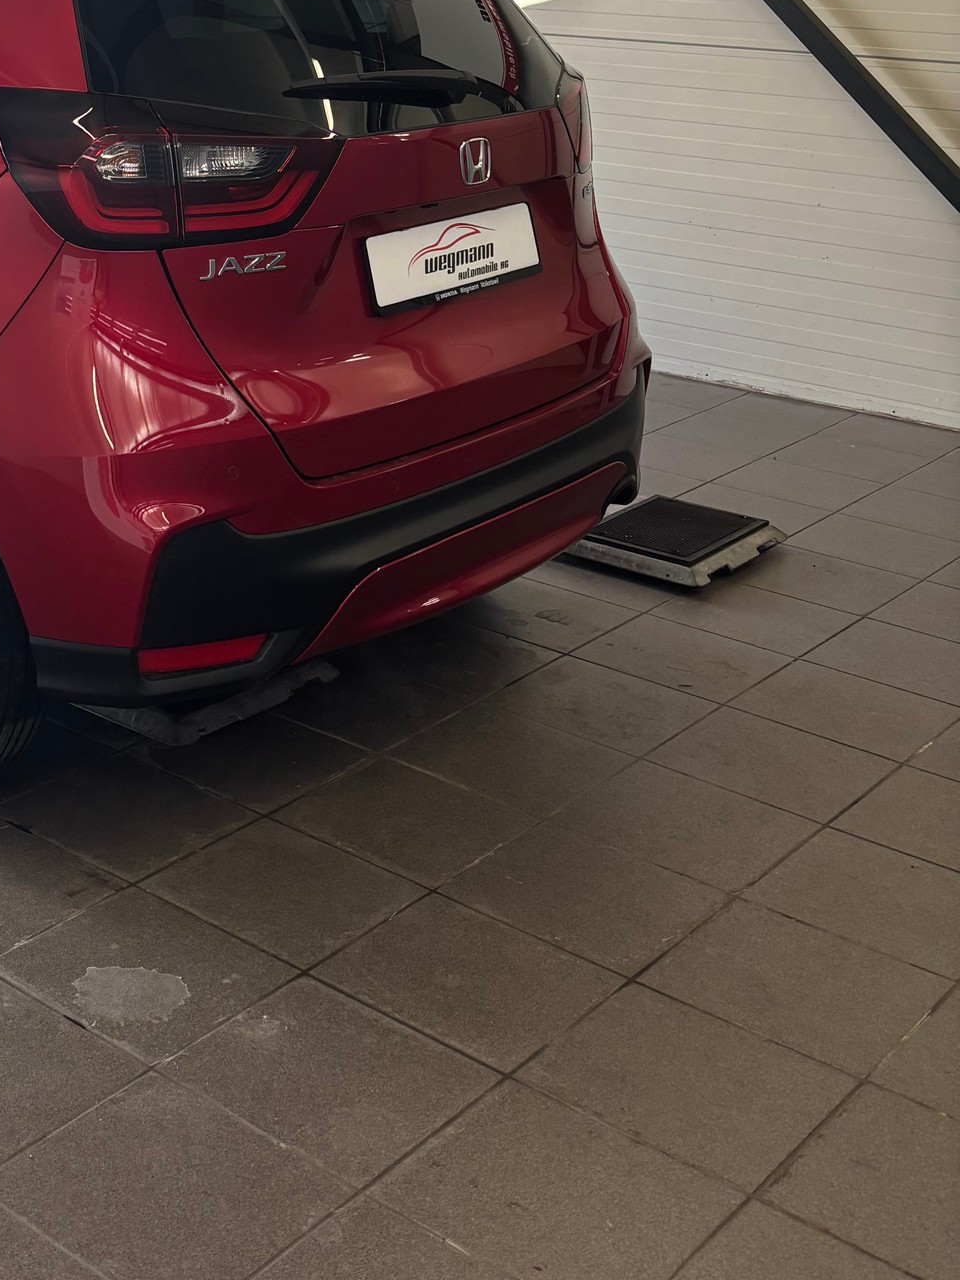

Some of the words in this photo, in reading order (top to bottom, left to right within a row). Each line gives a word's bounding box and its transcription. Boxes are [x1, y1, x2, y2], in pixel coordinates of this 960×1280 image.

[200, 251, 287, 281] JAZZ
[424, 242, 494, 275] wegmann
[500, 260, 509, 270] AG
